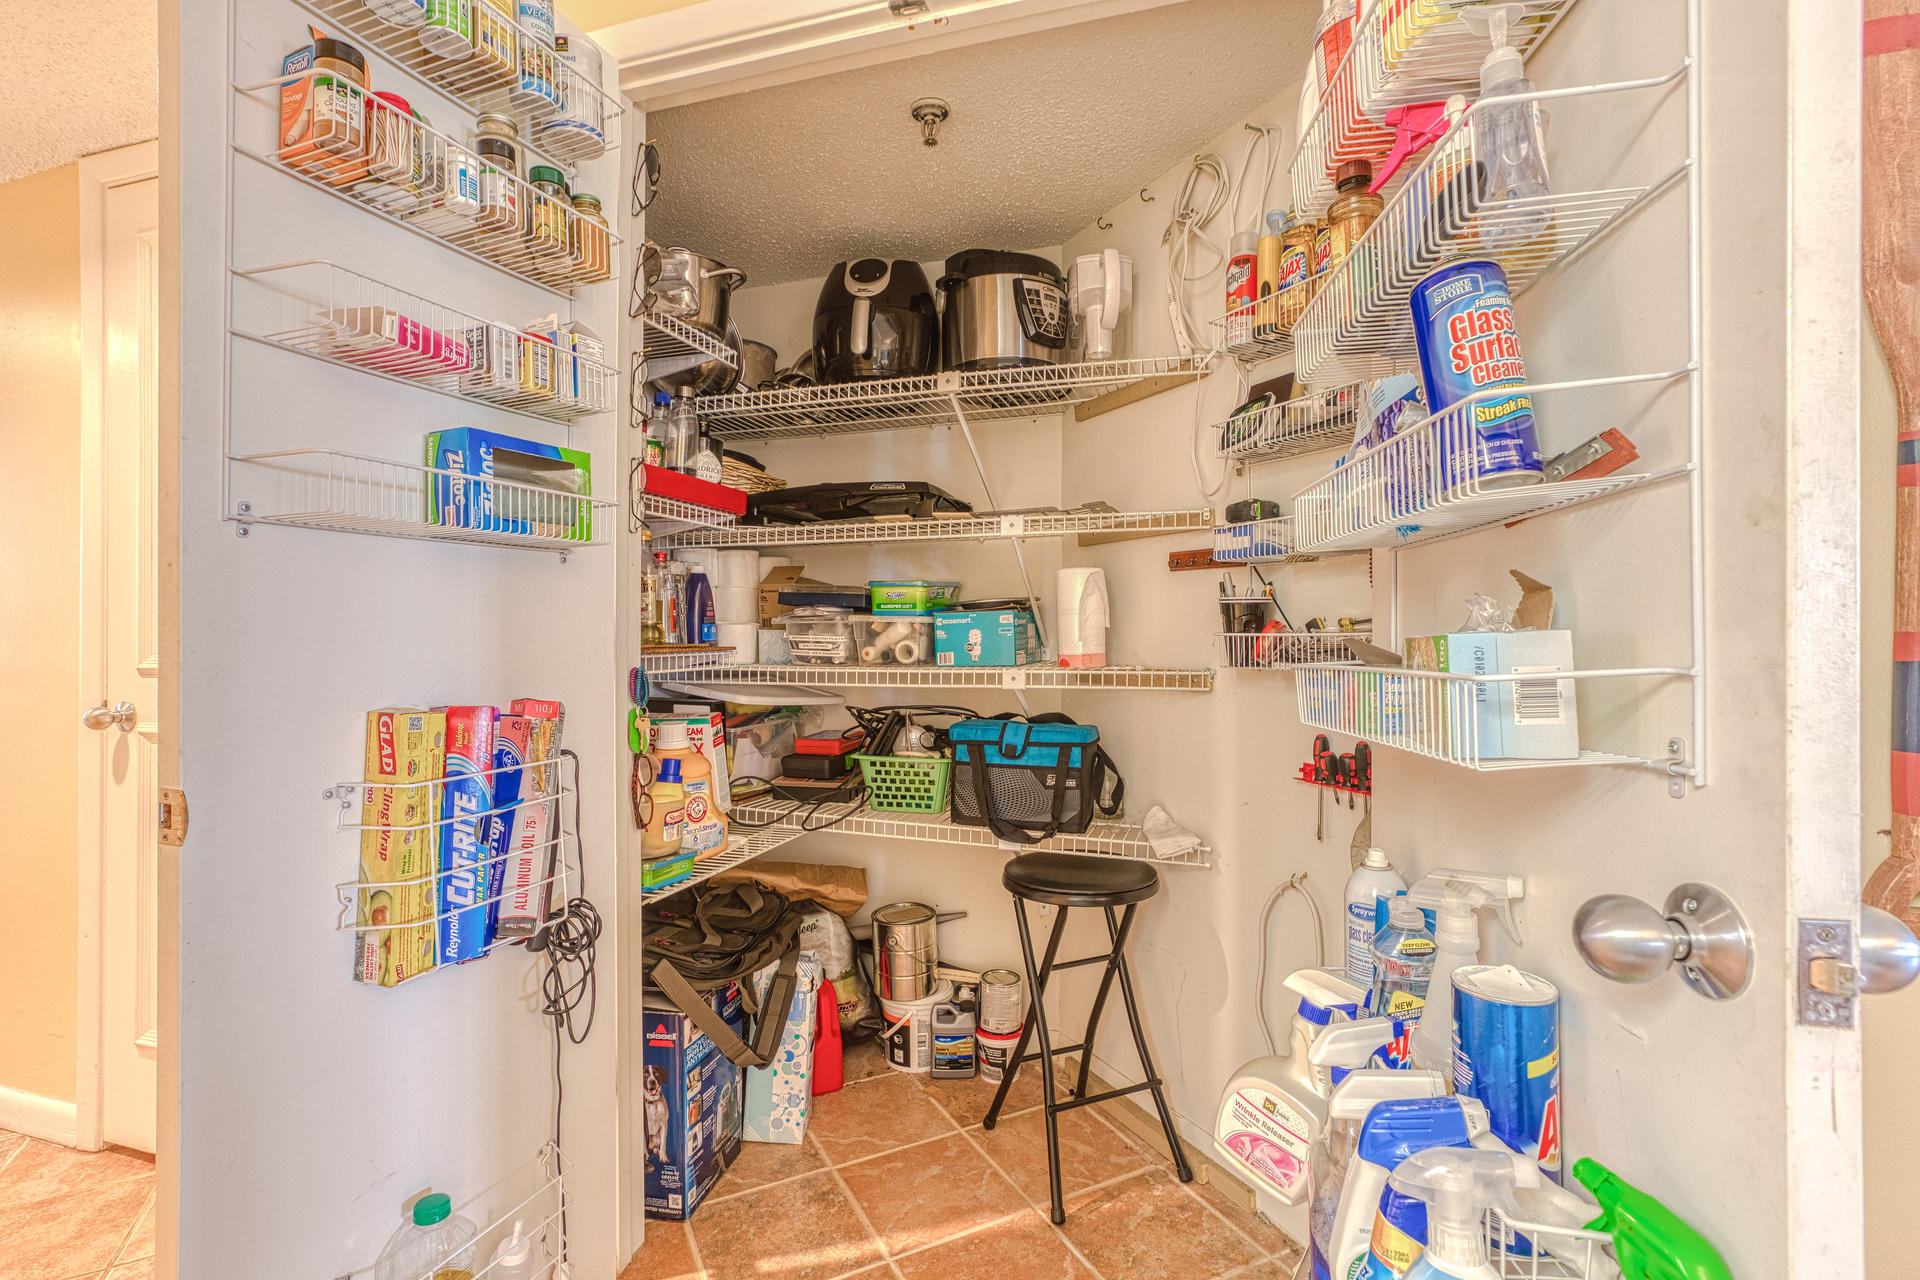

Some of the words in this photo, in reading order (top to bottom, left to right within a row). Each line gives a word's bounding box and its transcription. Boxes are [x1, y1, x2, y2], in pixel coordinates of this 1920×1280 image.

[286, 54, 309, 75] Rexall
[1280, 257, 1302, 284] AJAX
[1434, 284, 1472, 306] STORE
[1441, 278, 1471, 294] HOME
[1475, 297, 1508, 309] Foaming
[1449, 307, 1514, 343] Glass
[1450, 332, 1523, 373] Surfac
[1471, 361, 1525, 384] Cleane
[1476, 399, 1516, 422] Streak
[1517, 397, 1532, 409] FRE
[885, 591, 907, 600] Swiffer
[535, 703, 553, 713] FOIL
[456, 722, 465, 748] Baking
[512, 721, 519, 731] 75
[379, 715, 395, 773] GLAD
[480, 751, 491, 763] 75
[366, 785, 374, 804] 00
[380, 786, 393, 824] Cling
[447, 791, 478, 905] CUT-RITE
[514, 857, 534, 911] ALUMINUM
[526, 820, 537, 830] 75
[1351, 904, 1376, 917] Sprayw
[446, 904, 460, 958] Reynolds
[1362, 929, 1376, 944] clea
[1394, 1000, 1414, 1011] NEW
[1386, 1028, 1411, 1063] AJ
[1264, 1100, 1276, 1112] DG
[1235, 1099, 1261, 1124] Wrinkle
[1261, 1120, 1295, 1148] Releaser
